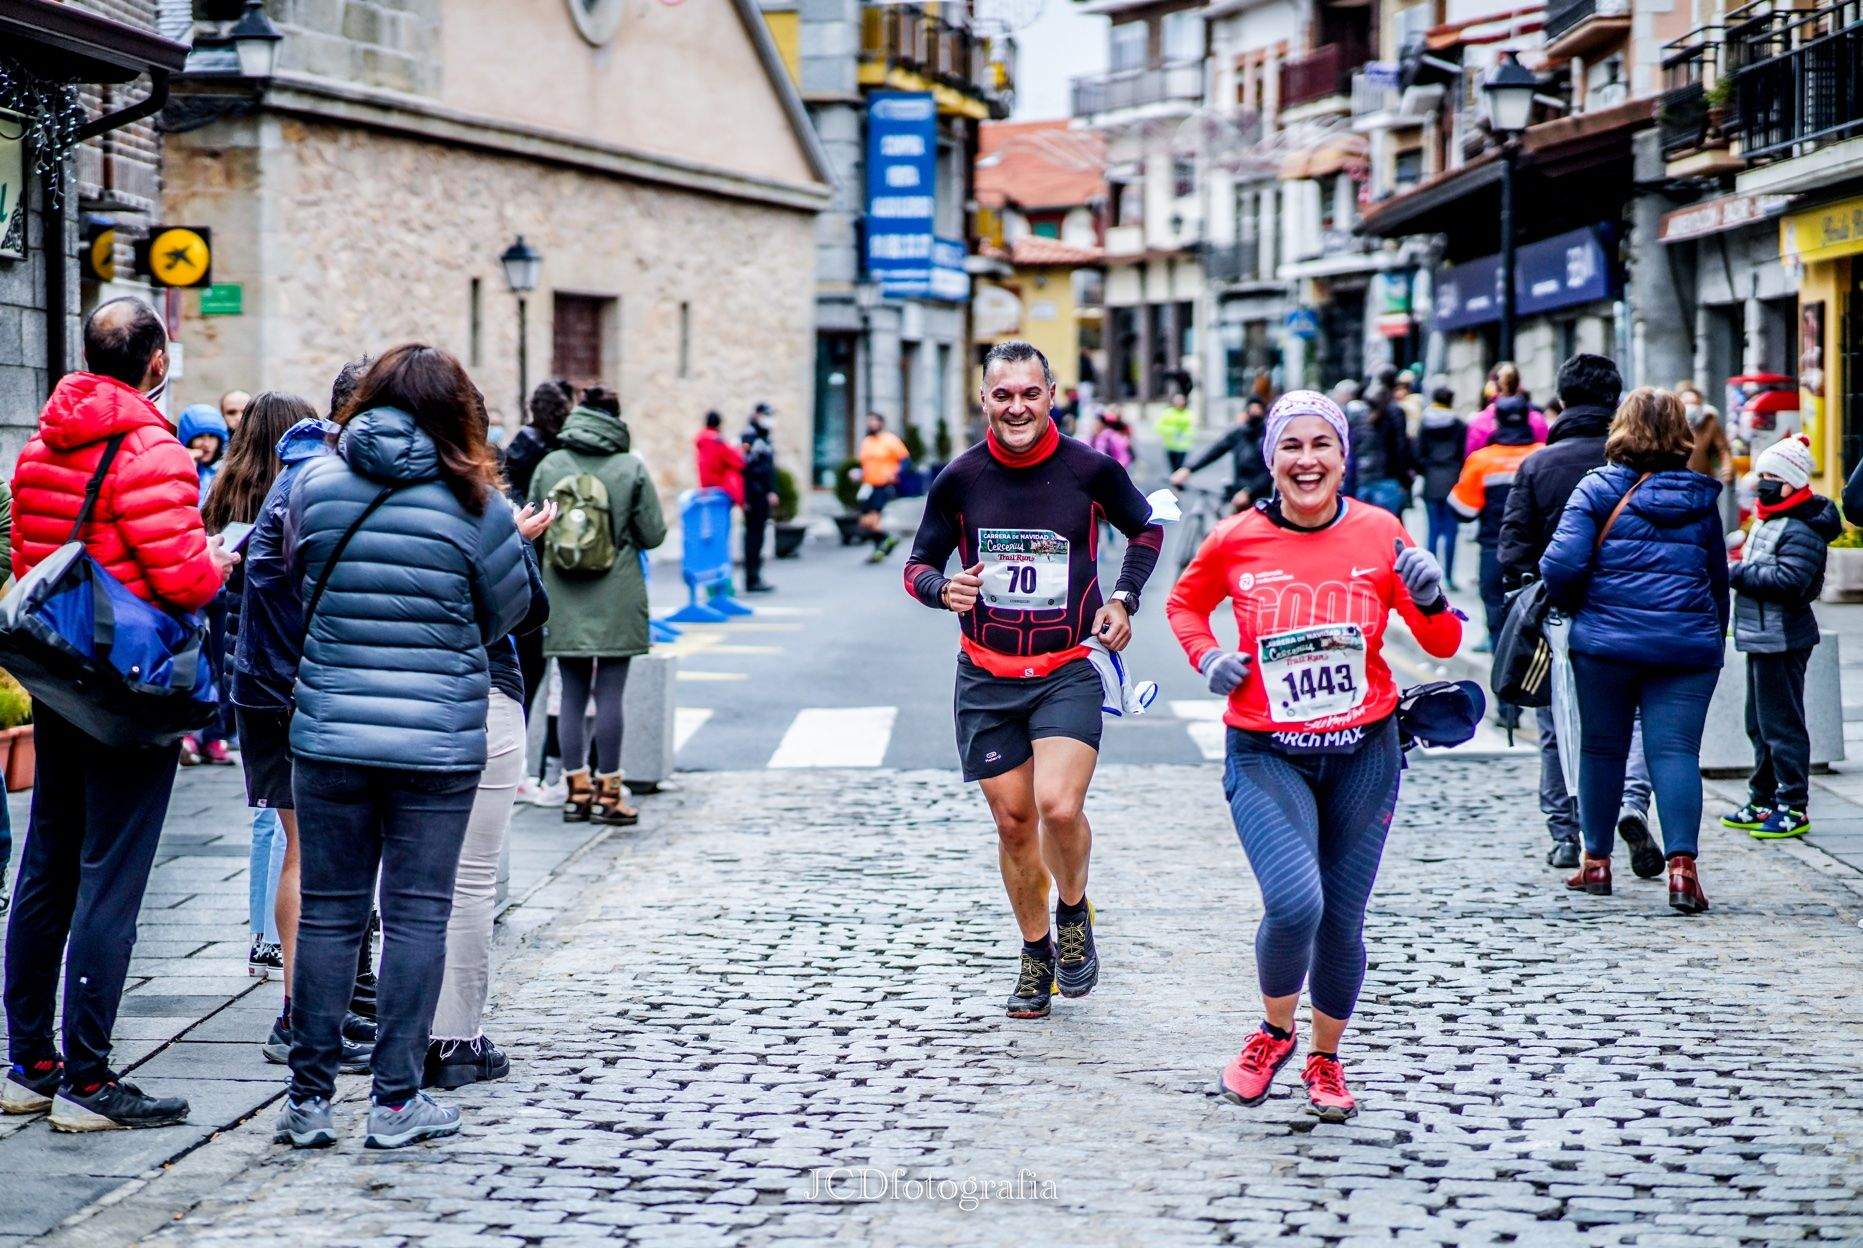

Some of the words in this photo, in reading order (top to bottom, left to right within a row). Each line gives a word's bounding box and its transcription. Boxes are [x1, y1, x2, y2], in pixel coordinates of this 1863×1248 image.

[1006, 565, 1037, 594] 70
[1282, 664, 1353, 703] 1443
[1323, 725, 1366, 747] MAX
